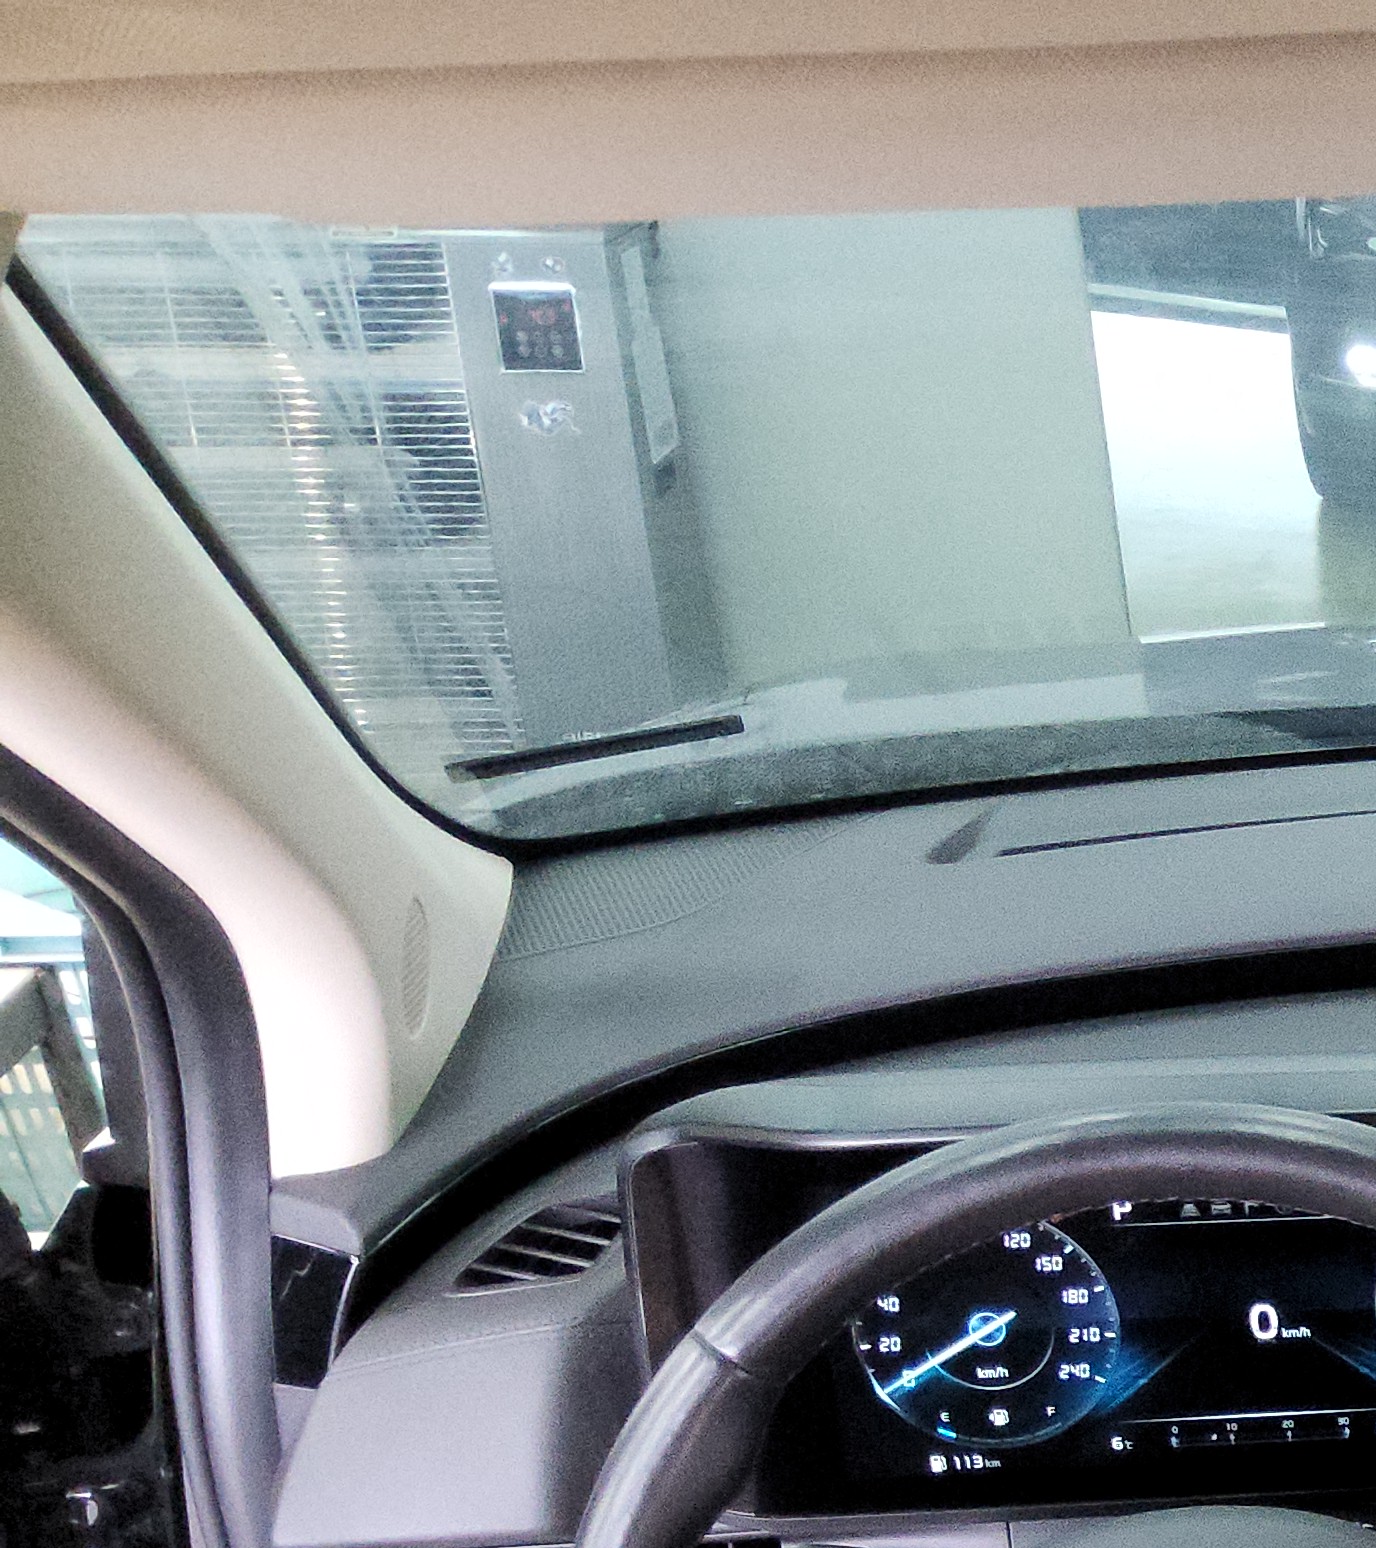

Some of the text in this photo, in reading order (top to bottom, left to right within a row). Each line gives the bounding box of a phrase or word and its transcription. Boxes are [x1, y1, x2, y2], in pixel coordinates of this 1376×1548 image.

[1003, 1231, 1031, 1249] 120
[1035, 1254, 1063, 1272] 150
[876, 1295, 900, 1313] 40
[1061, 1287, 1089, 1305] 180
[1248, 1303, 1312, 1340] 0 km/h
[1068, 1326, 1101, 1344] 210
[878, 1336, 902, 1353] 20
[975, 1366, 1010, 1379] km/h
[1058, 1362, 1091, 1380] 240
[1226, 1422, 1238, 1431] 10
[1281, 1419, 1295, 1429] 20
